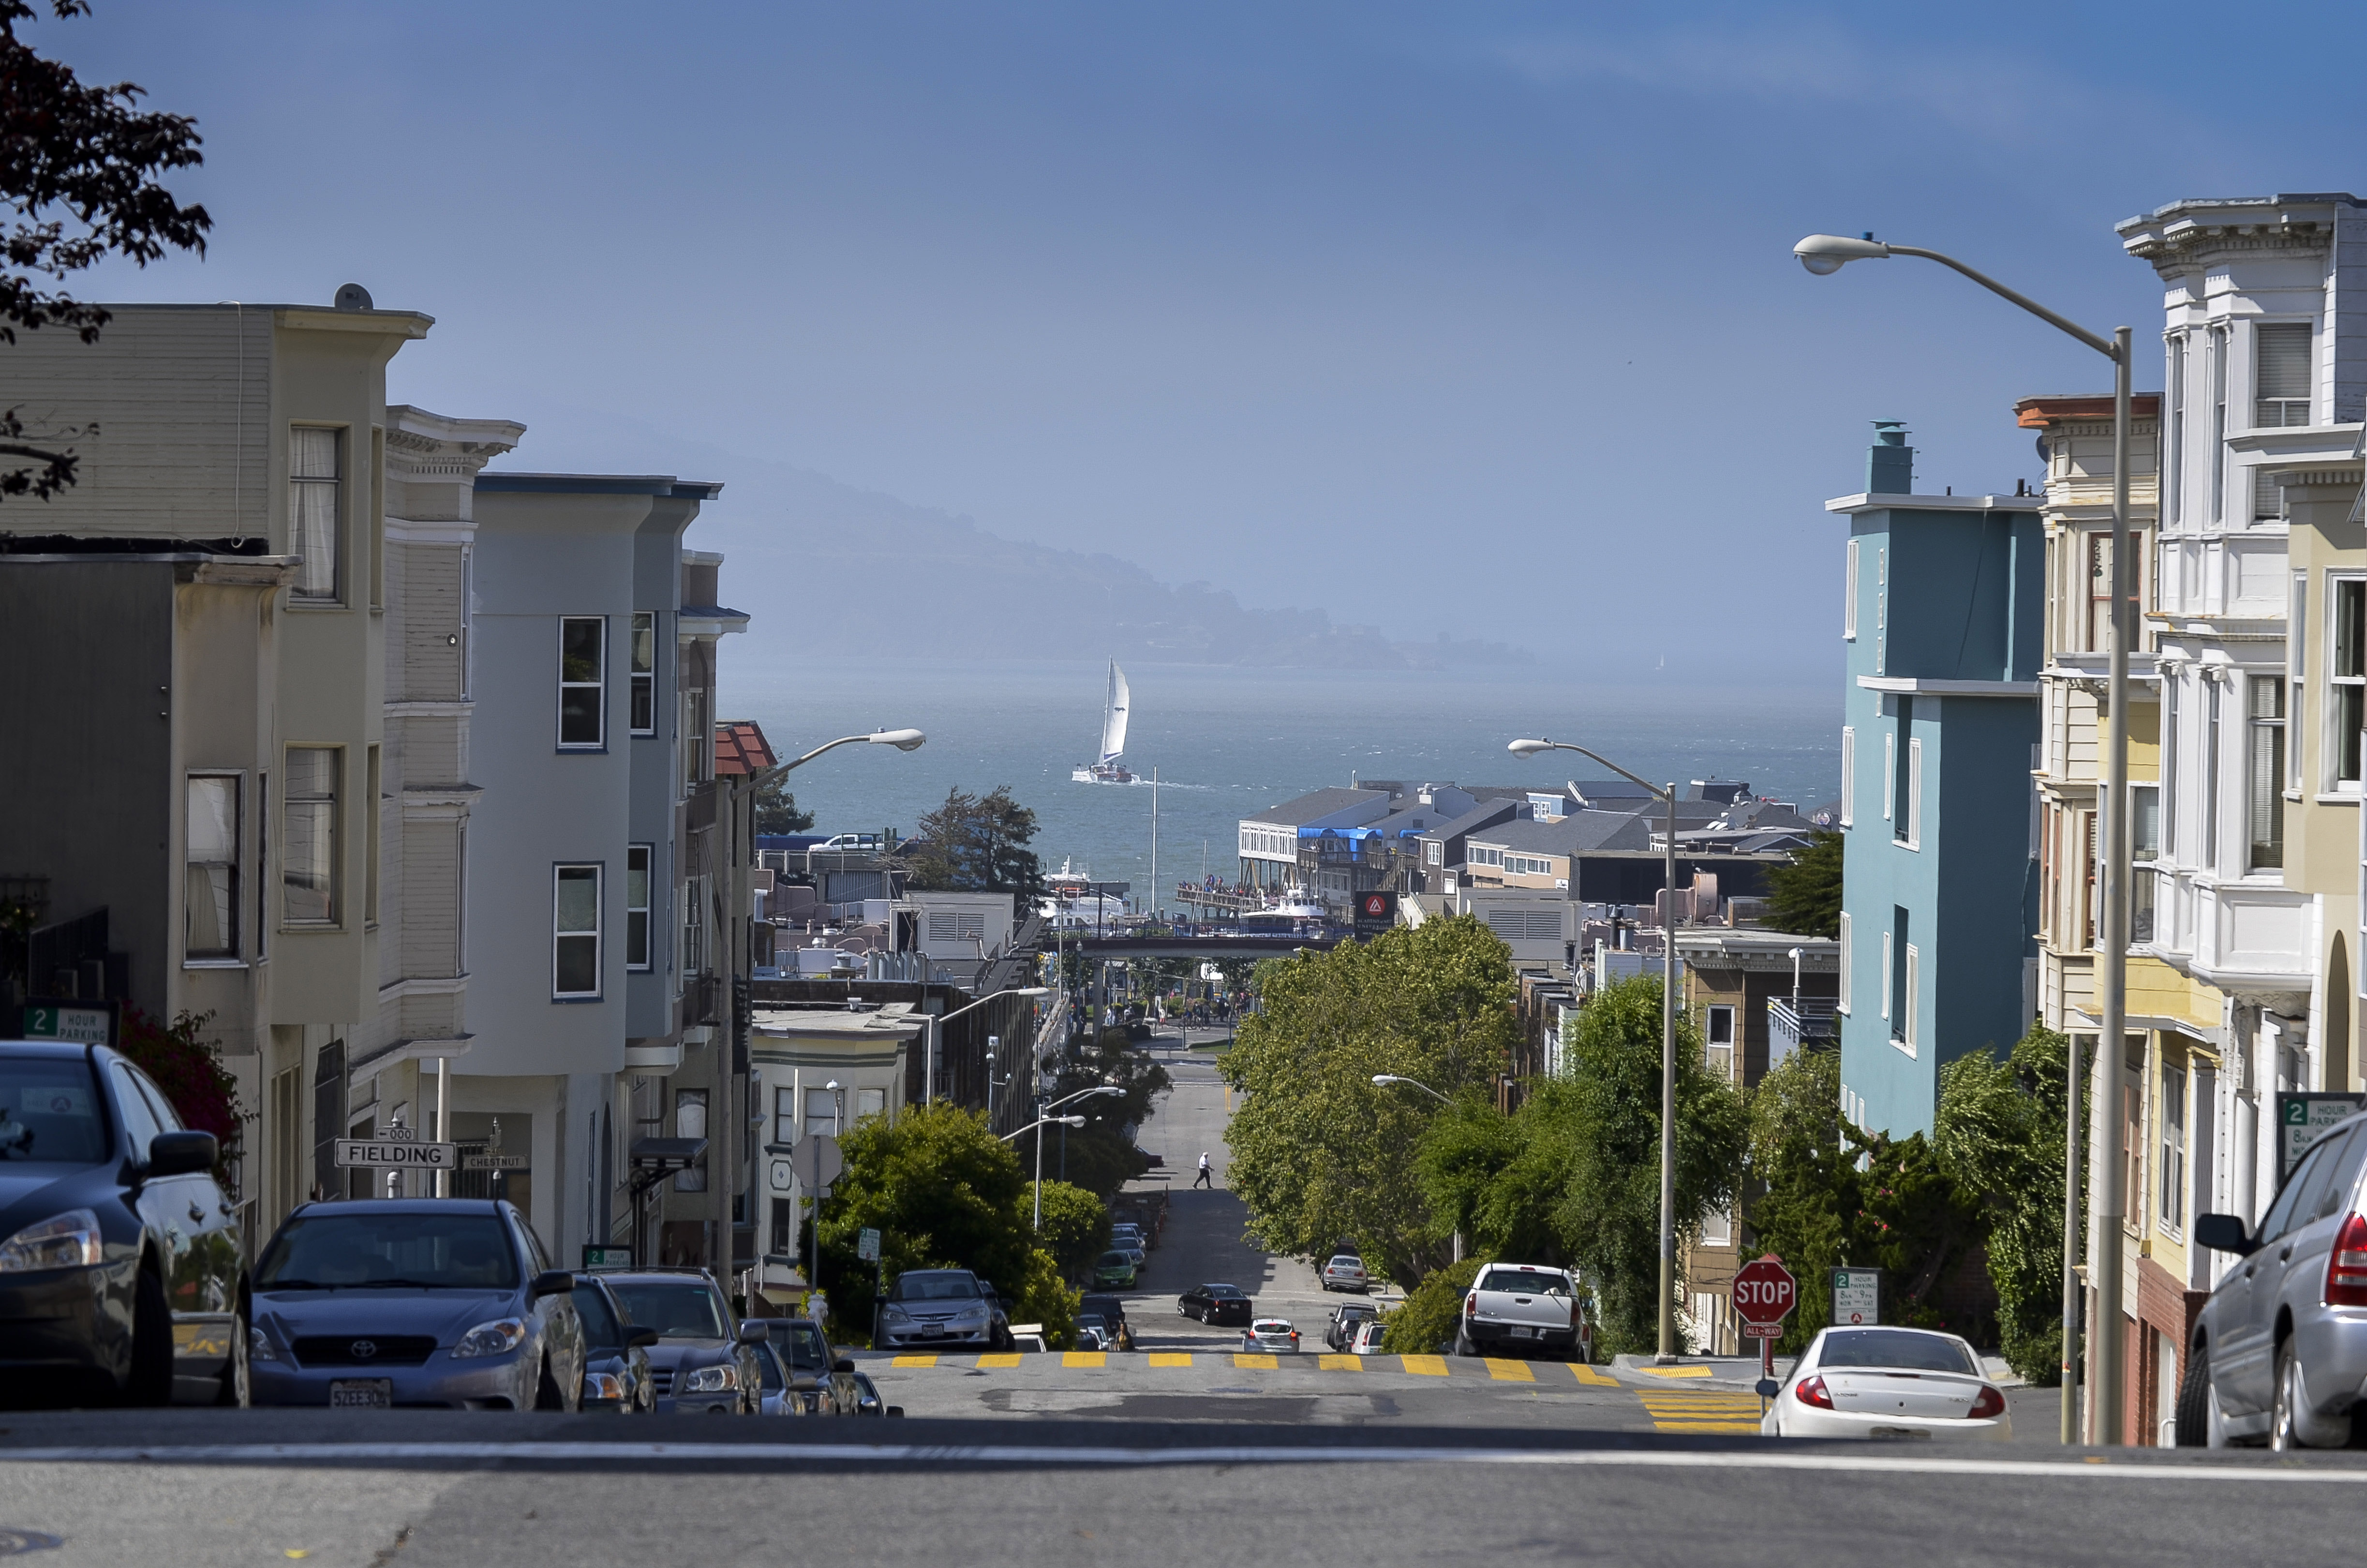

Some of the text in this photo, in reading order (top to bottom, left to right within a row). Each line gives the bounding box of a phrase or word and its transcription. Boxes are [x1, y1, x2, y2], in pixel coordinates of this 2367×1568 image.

[34, 1009, 97, 1030] 2 HOUR
[59, 1028, 106, 1041] PARKING
[2290, 1103, 2347, 1121] 2 HOUR
[349, 1146, 441, 1163] FIELDING
[470, 1158, 519, 1167] CHESTNUT
[592, 1251, 598, 1262] 2
[1838, 1275, 1846, 1286] 2
[1736, 1281, 1790, 1304] STOP
[1746, 1327, 1782, 1335] ALL-WAY
